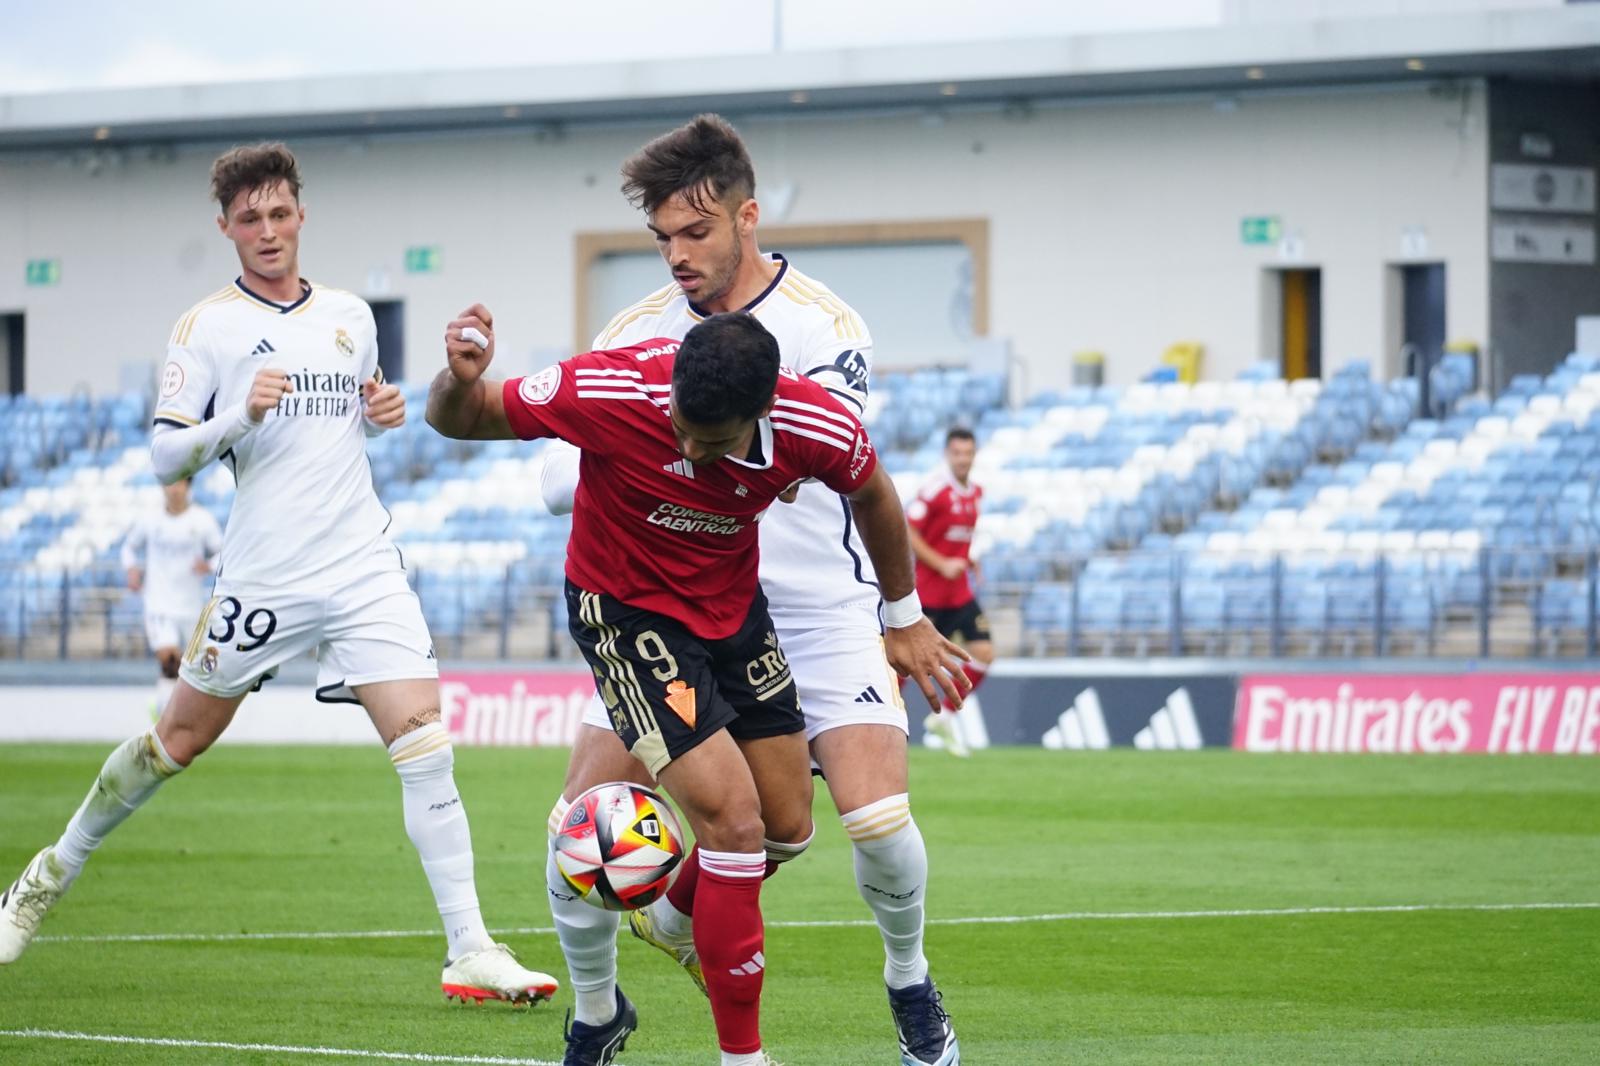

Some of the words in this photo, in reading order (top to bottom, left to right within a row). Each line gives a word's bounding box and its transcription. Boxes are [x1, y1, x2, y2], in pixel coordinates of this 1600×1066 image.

[276, 397, 300, 416] FLY
[306, 397, 348, 416] BETTER
[646, 511, 744, 535] LAENTRAD
[658, 503, 736, 524] COMPRA
[208, 596, 277, 652] 39
[635, 630, 679, 682] 9
[440, 680, 587, 746] Emirat
[1246, 683, 1473, 753] Emirates
[1487, 686, 1557, 754] FLY
